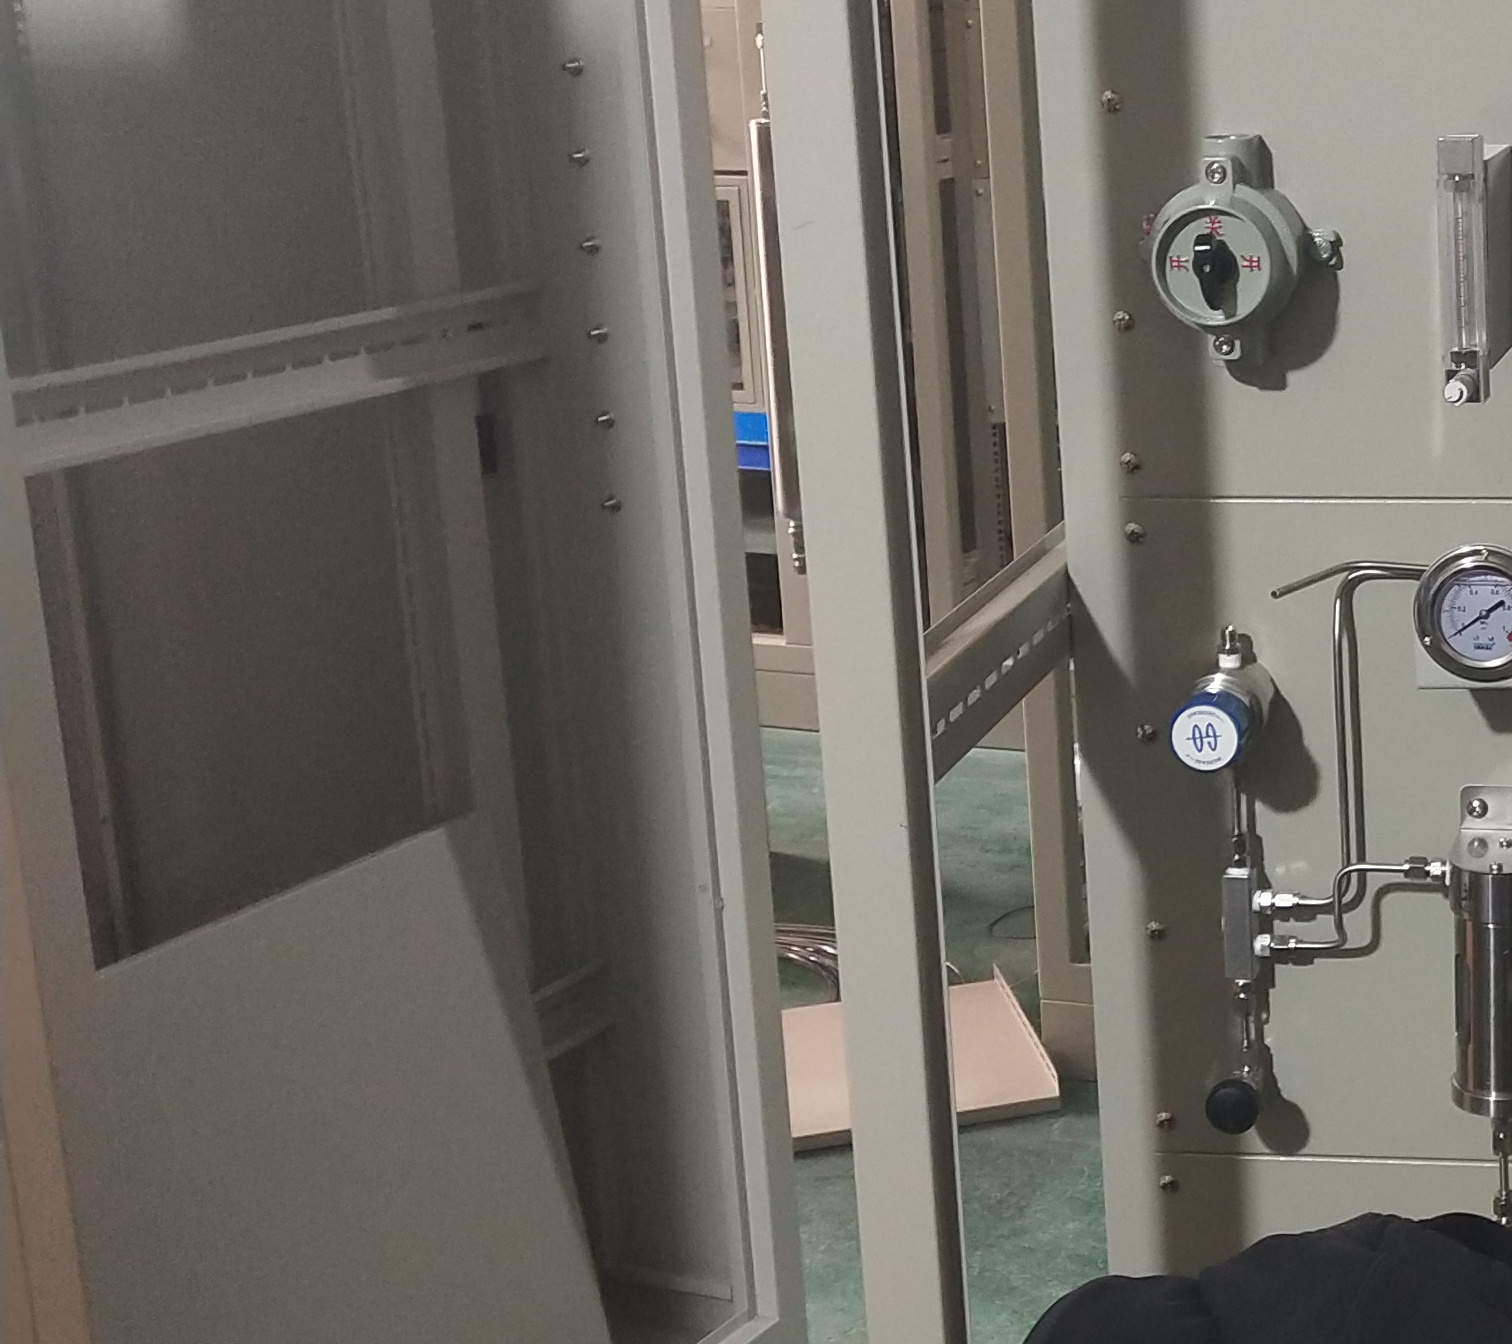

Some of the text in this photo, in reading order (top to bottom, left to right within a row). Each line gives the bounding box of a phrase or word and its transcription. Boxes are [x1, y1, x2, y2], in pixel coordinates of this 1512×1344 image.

[1204, 213, 1225, 238] 关
[1168, 255, 1190, 272] 开
[1240, 254, 1262, 273] 开
